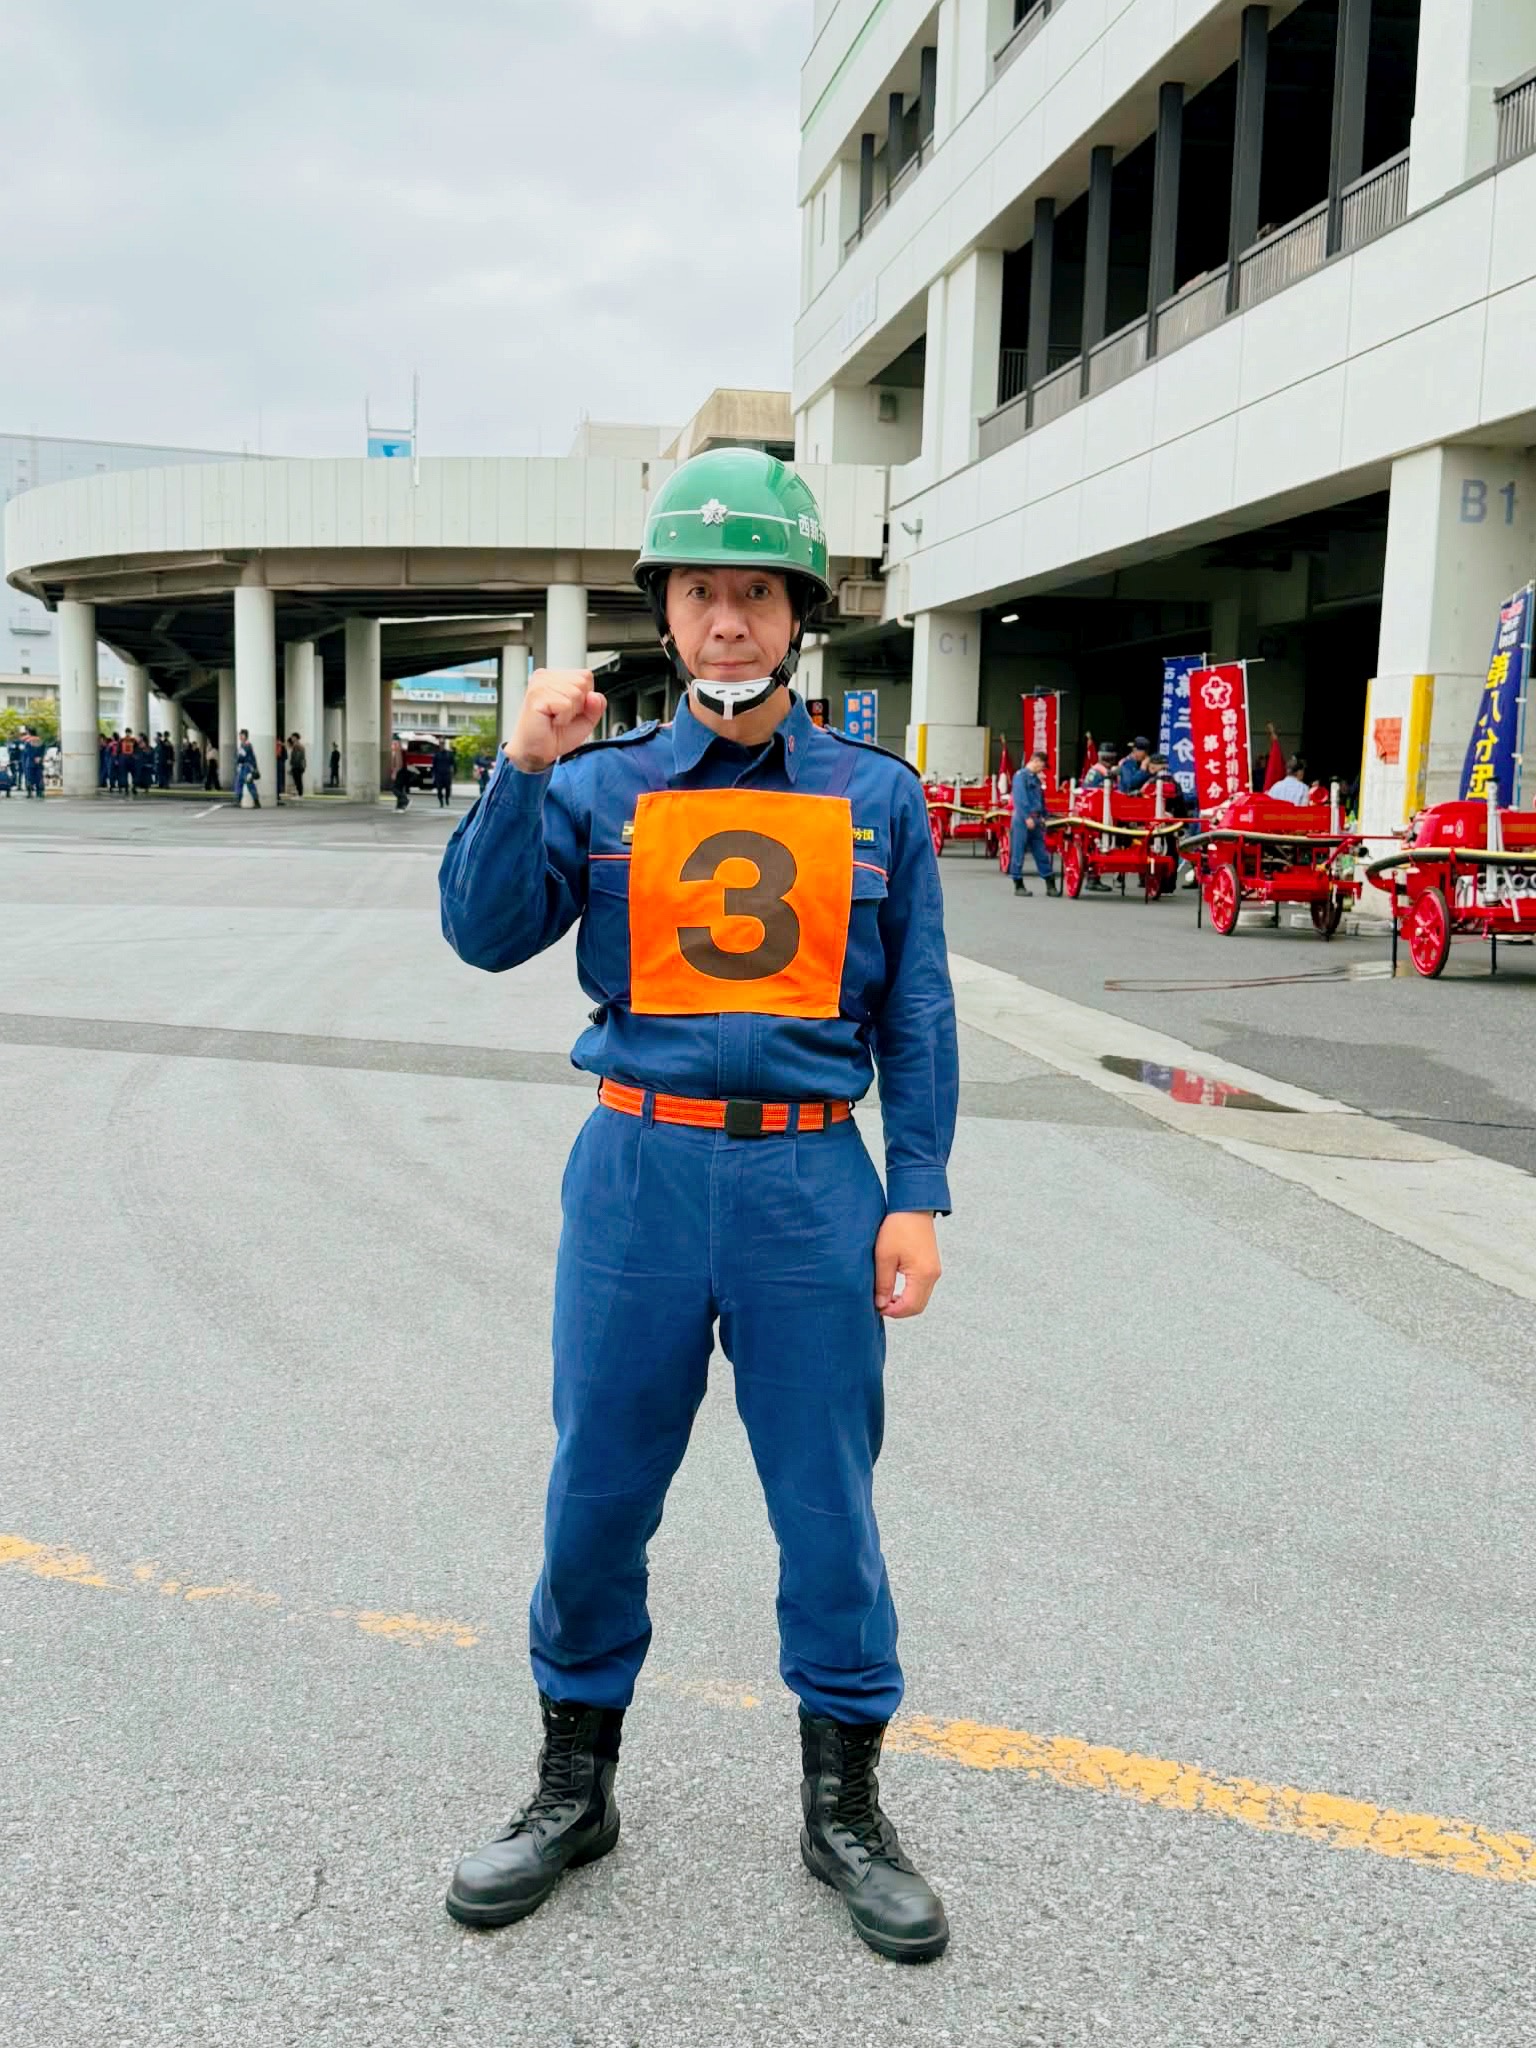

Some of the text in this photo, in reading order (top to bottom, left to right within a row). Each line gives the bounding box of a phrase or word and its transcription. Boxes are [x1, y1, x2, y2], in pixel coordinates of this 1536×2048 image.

[1460, 479, 1516, 527] B1
[939, 632, 968, 656] C1
[677, 830, 800, 980] 3
